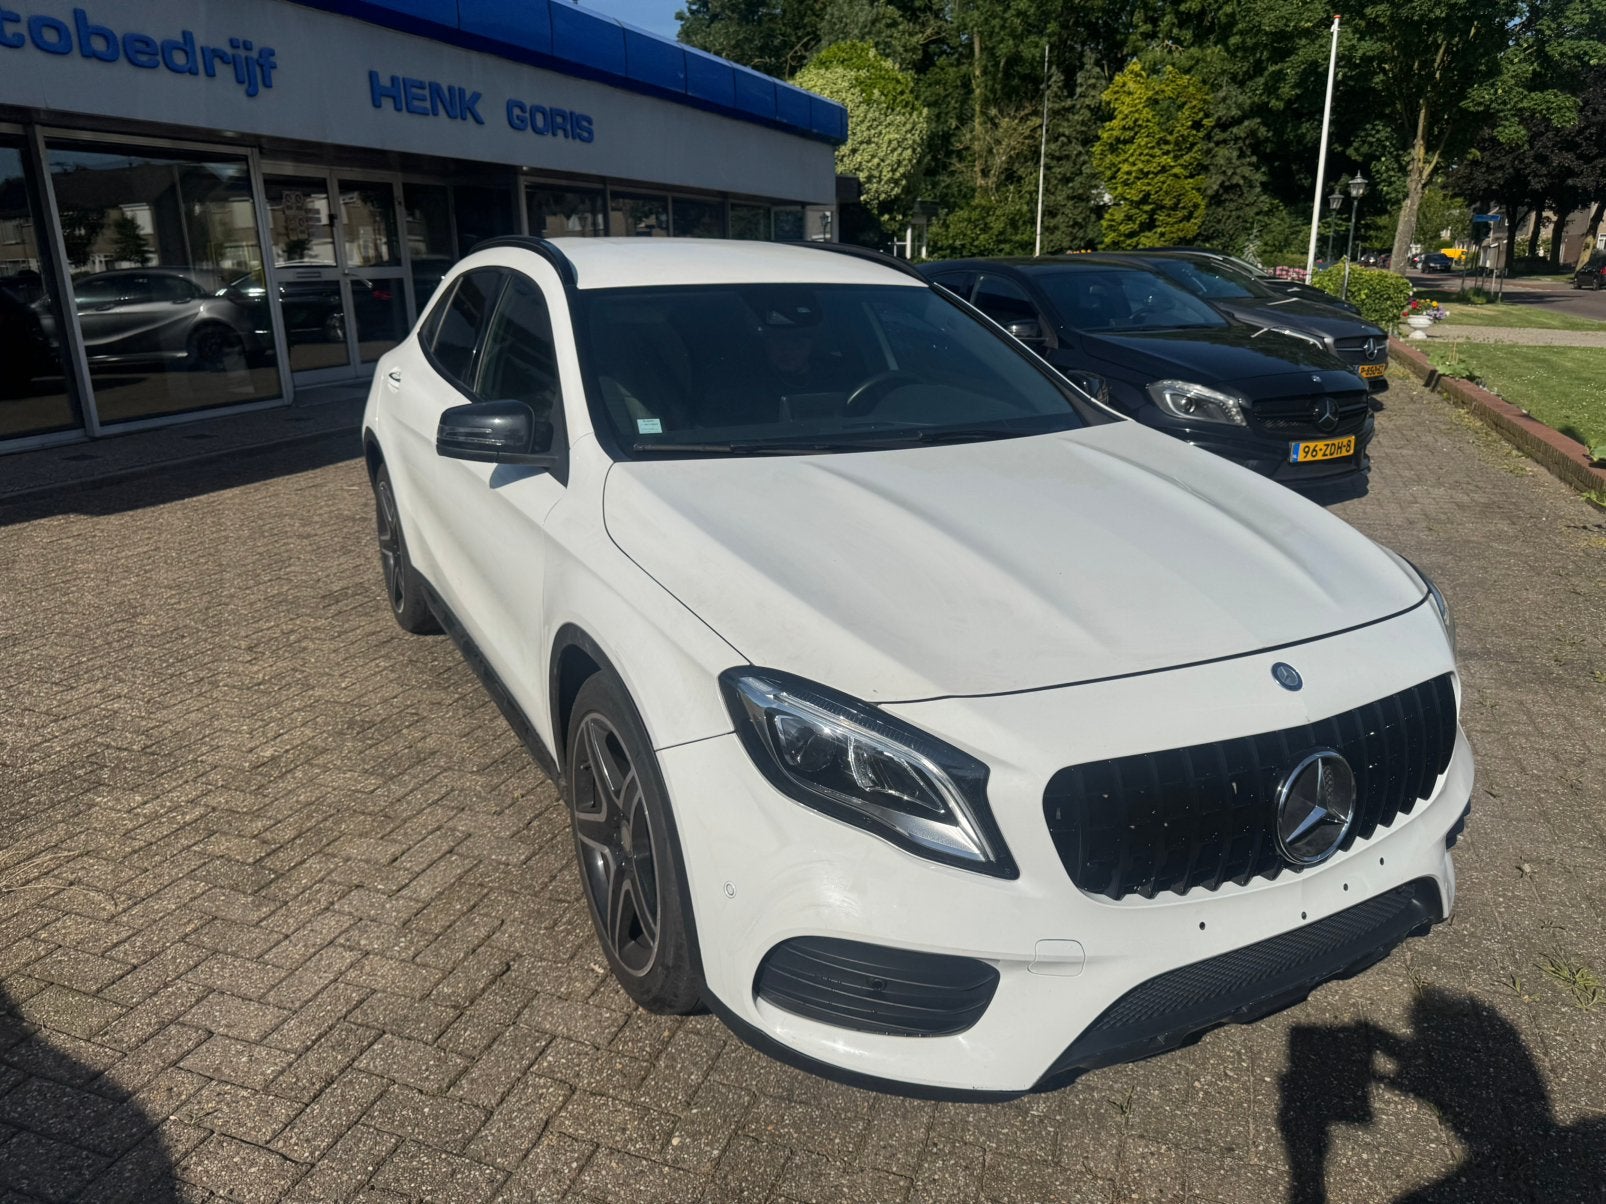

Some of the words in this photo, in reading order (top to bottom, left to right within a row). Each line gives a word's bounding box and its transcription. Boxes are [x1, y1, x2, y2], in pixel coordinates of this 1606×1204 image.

[368, 70, 485, 125] HENK
[506, 98, 595, 143] GORIS
[1302, 439, 1352, 459] 96-ZDH-8
